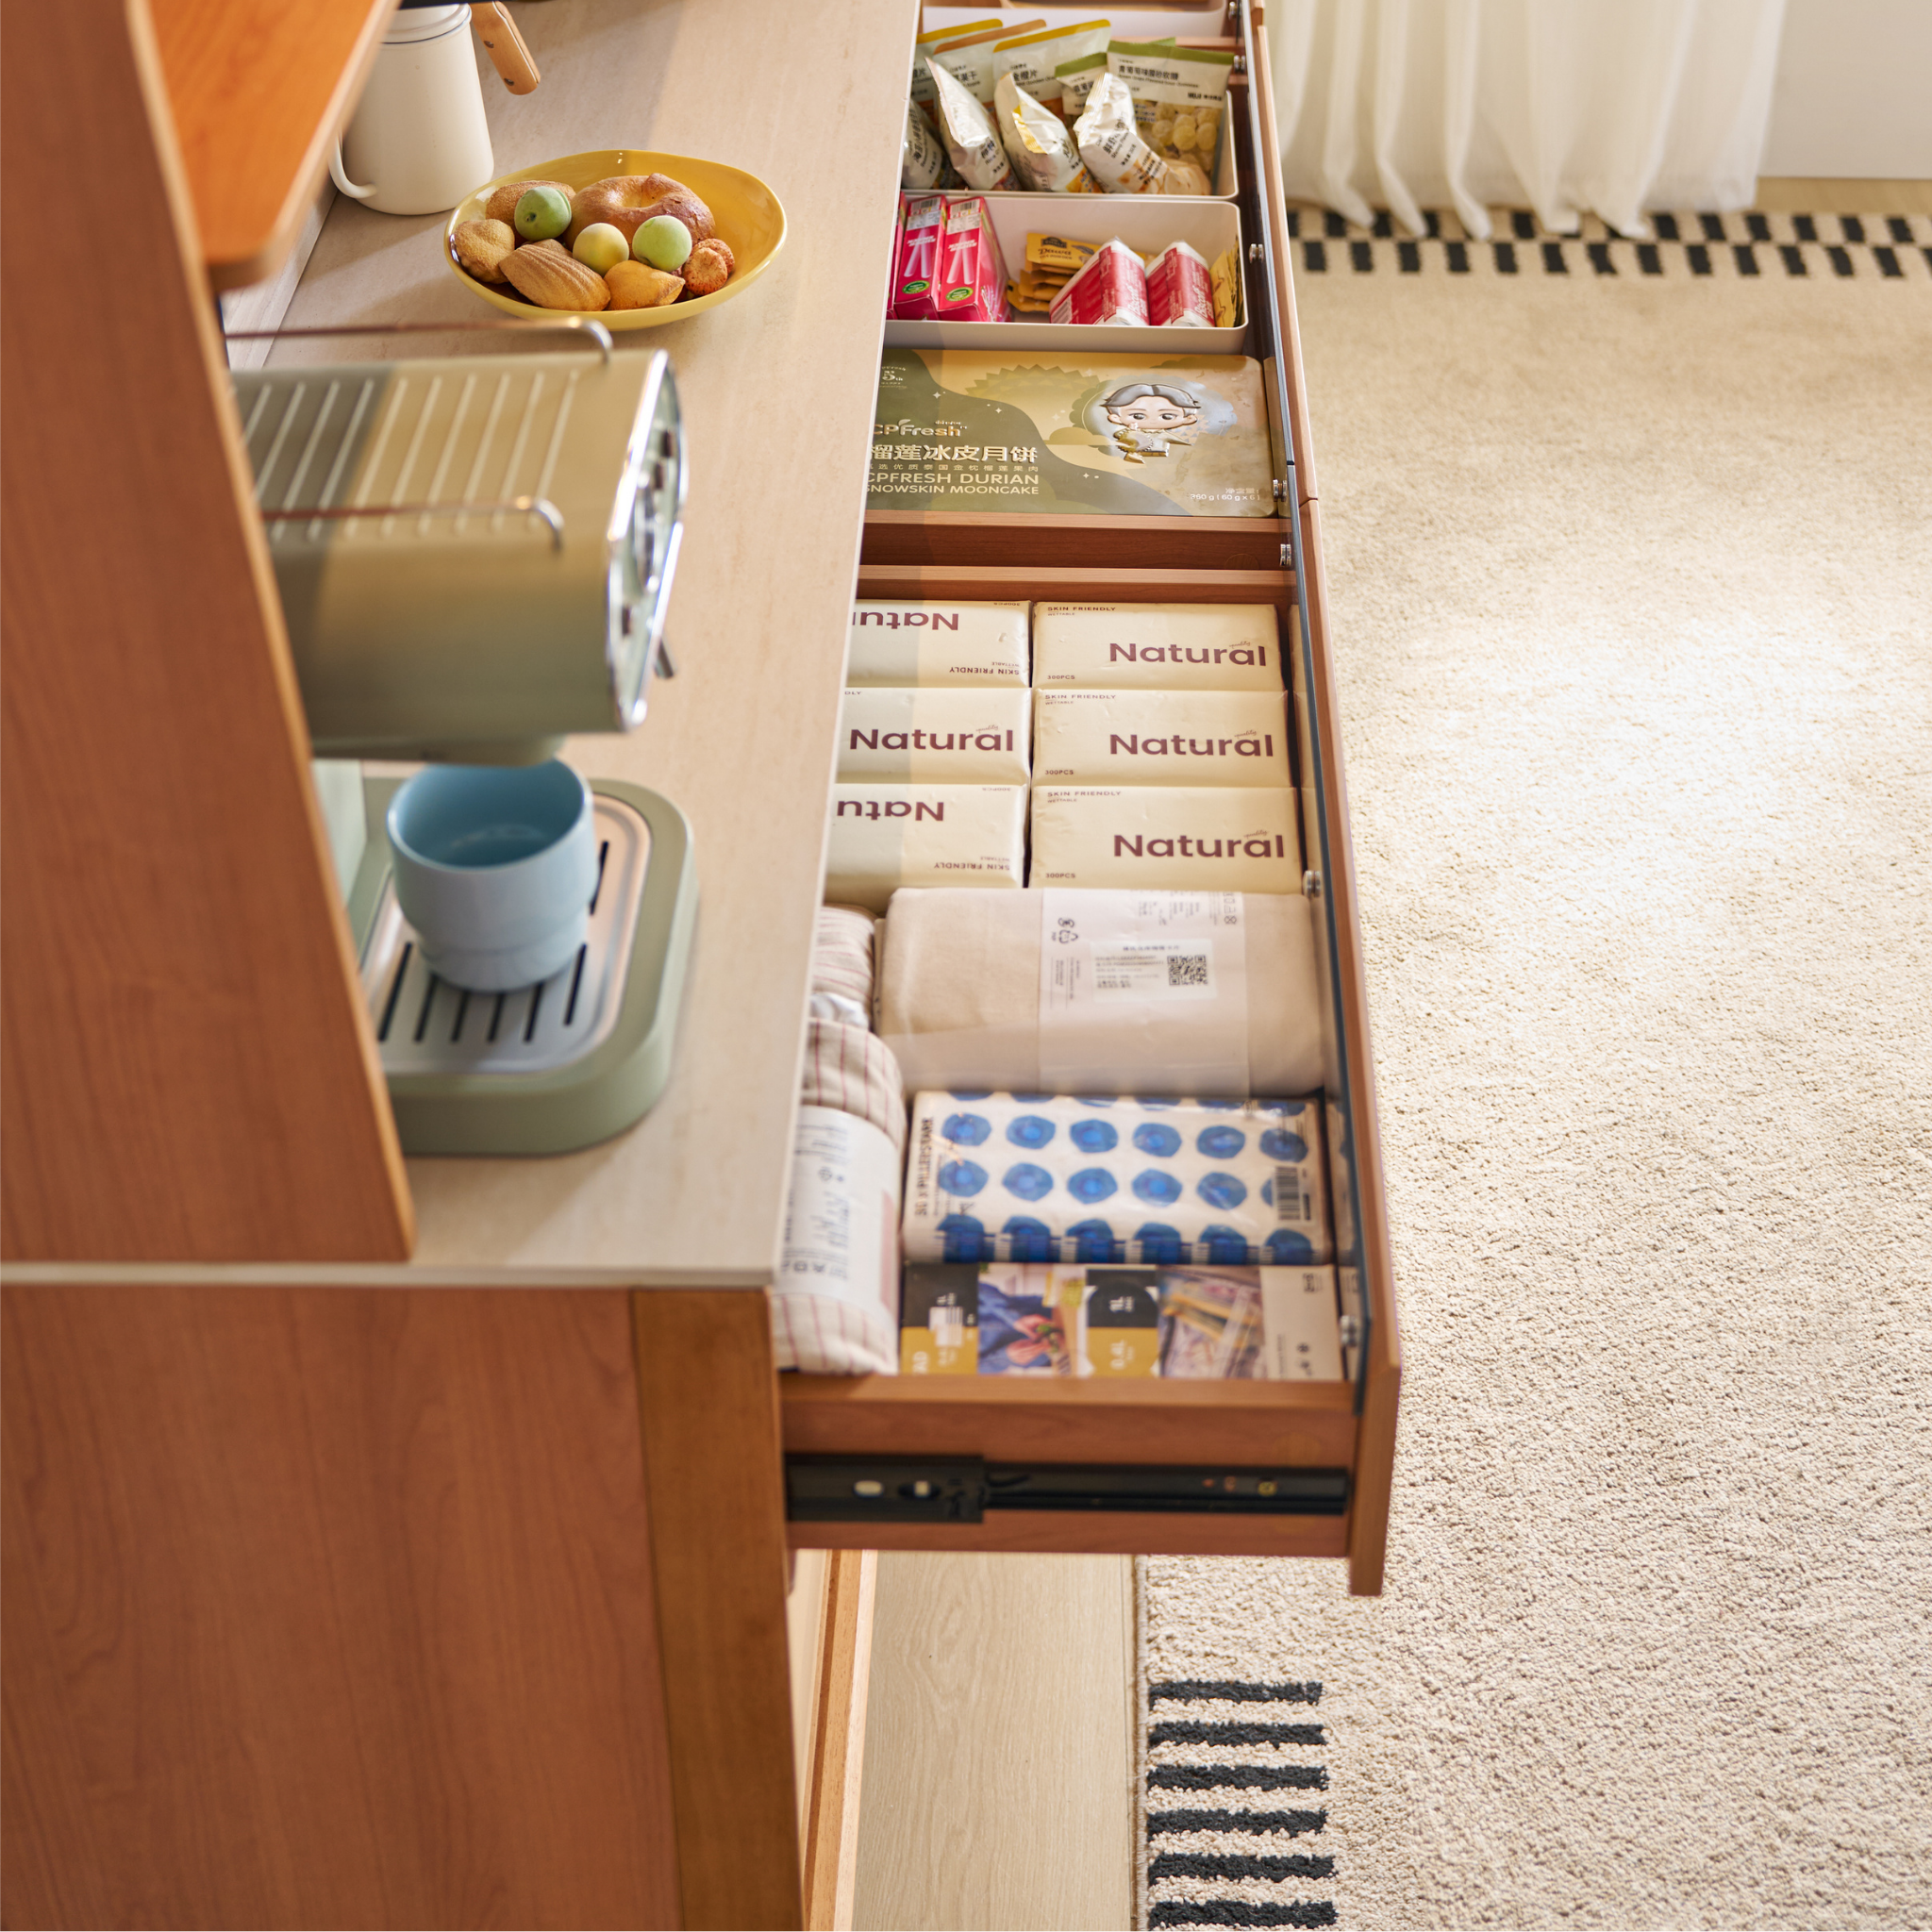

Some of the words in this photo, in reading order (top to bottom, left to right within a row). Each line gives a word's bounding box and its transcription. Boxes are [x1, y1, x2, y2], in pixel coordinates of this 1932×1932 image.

[1193, 285, 1208, 317] Biscoff
[870, 444, 1038, 463] 榴莲冰皮月饼
[868, 473, 951, 485] CPFRESH
[959, 474, 1040, 485] DURIAN
[950, 485, 1040, 495] MOONCAKE
[852, 611, 958, 631] Natu
[1109, 642, 1267, 667] Natural
[949, 666, 993, 675] FRIENDLY
[850, 729, 1014, 751] Natural
[1109, 734, 1274, 758] Natural
[1113, 834, 1284, 858] Natural
